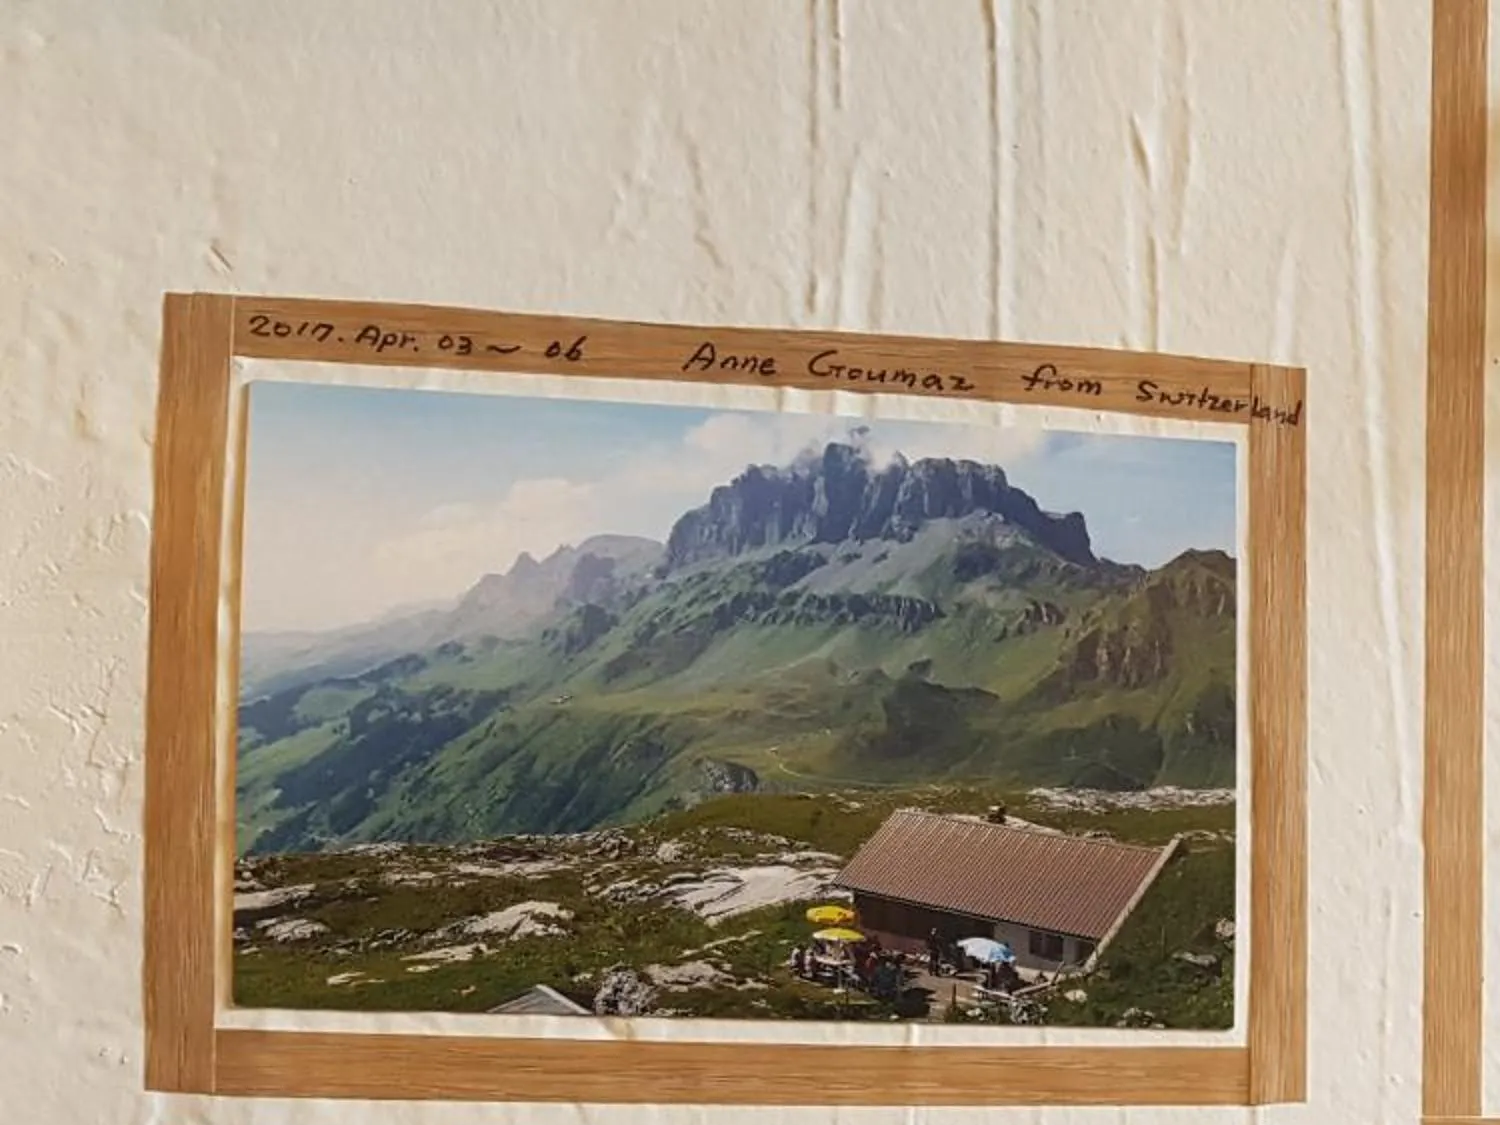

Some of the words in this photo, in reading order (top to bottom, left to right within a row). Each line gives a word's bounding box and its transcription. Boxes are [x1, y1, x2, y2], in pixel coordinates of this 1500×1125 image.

[438, 333, 473, 356] 03
[544, 335, 590, 362] 06
[682, 341, 777, 377] Anne
[1021, 362, 1103, 397] from
[1136, 379, 1303, 428] Switzerland
